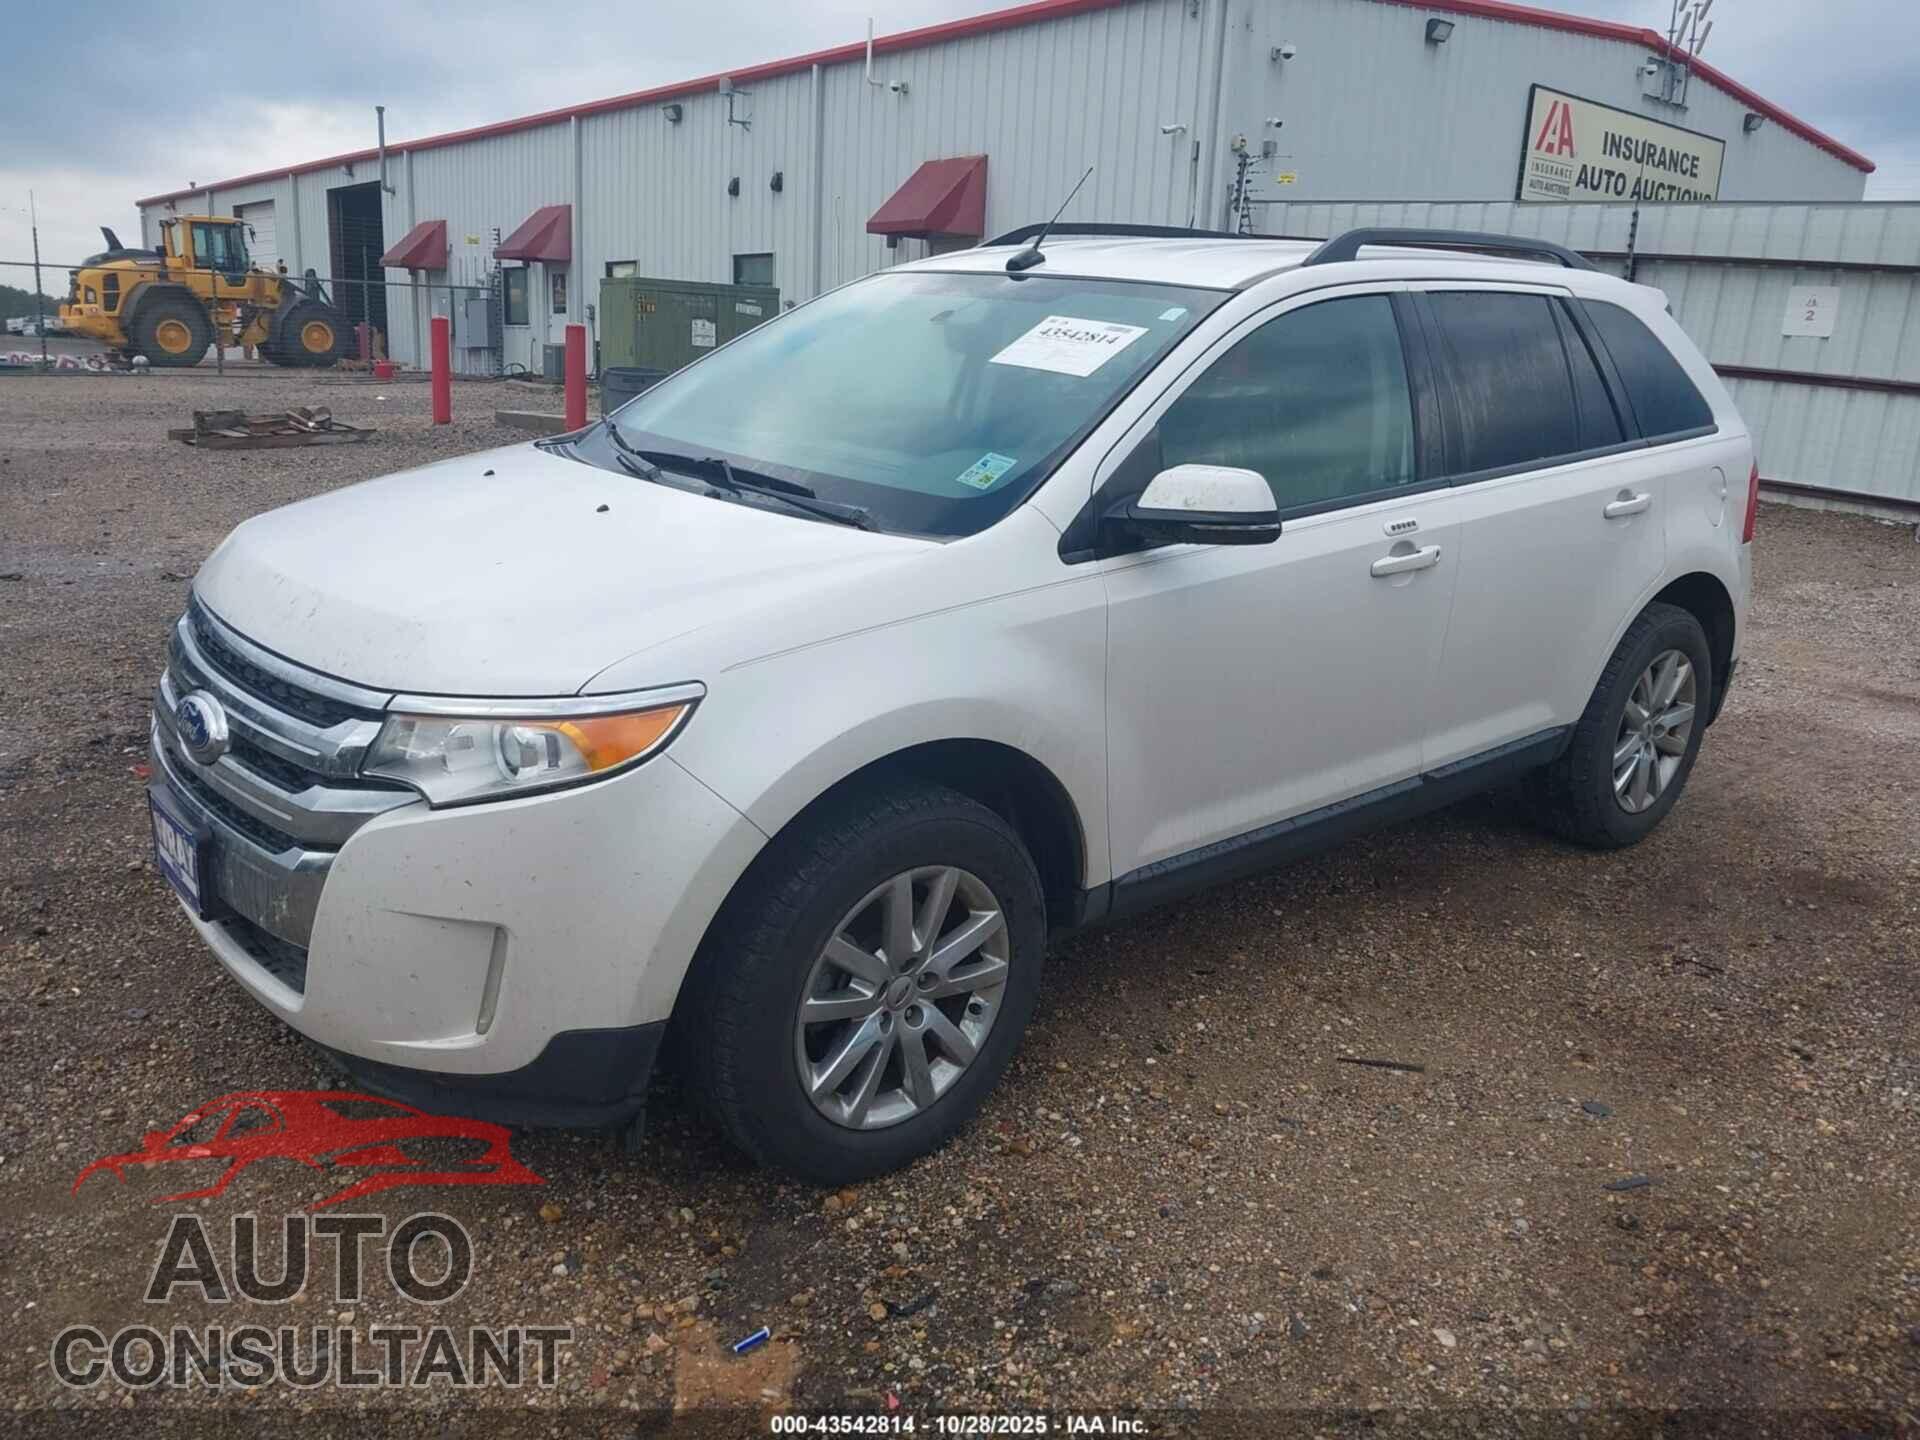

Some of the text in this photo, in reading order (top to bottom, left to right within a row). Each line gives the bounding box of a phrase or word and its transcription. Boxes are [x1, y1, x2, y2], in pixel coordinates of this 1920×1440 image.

[1602, 131, 1700, 179] INSURANCE
[1530, 161, 1573, 180] INSURANCE
[1576, 163, 1627, 197] AUTO
[1804, 310, 1816, 321] 2
[1040, 327, 1120, 345] 43542814
